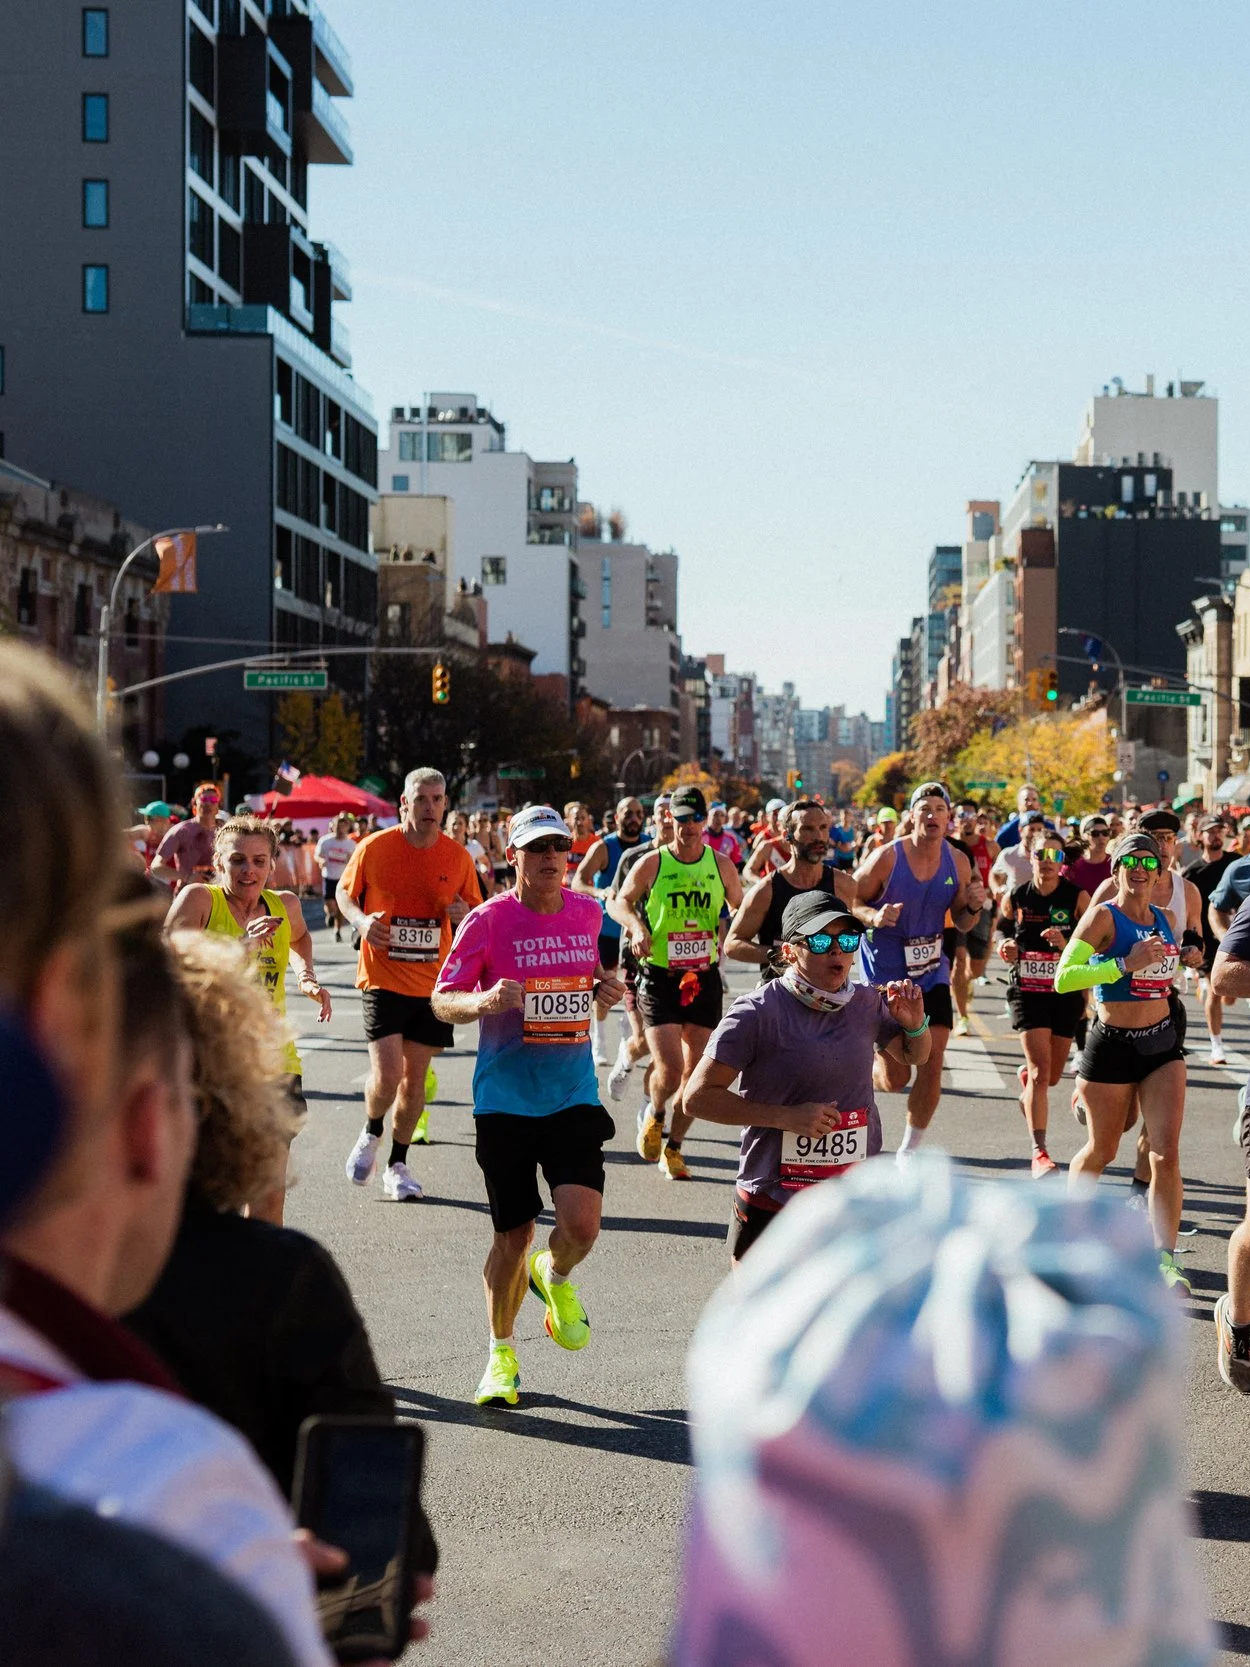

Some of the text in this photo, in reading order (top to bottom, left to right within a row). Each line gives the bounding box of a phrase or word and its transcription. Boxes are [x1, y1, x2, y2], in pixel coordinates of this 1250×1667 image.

[257, 675, 299, 686] Pacific
[1136, 692, 1176, 703] Pacific
[667, 890, 711, 909] TYM
[398, 928, 433, 943] 8316
[513, 934, 593, 953] TOTAL TRI
[674, 941, 707, 955] 9804
[514, 949, 595, 968] TRAINING
[1023, 961, 1059, 975] 1848
[535, 979, 551, 990] tcs
[531, 992, 590, 1015] 10858
[1125, 1027, 1159, 1038] NIKE
[796, 1130, 857, 1157] 9485
